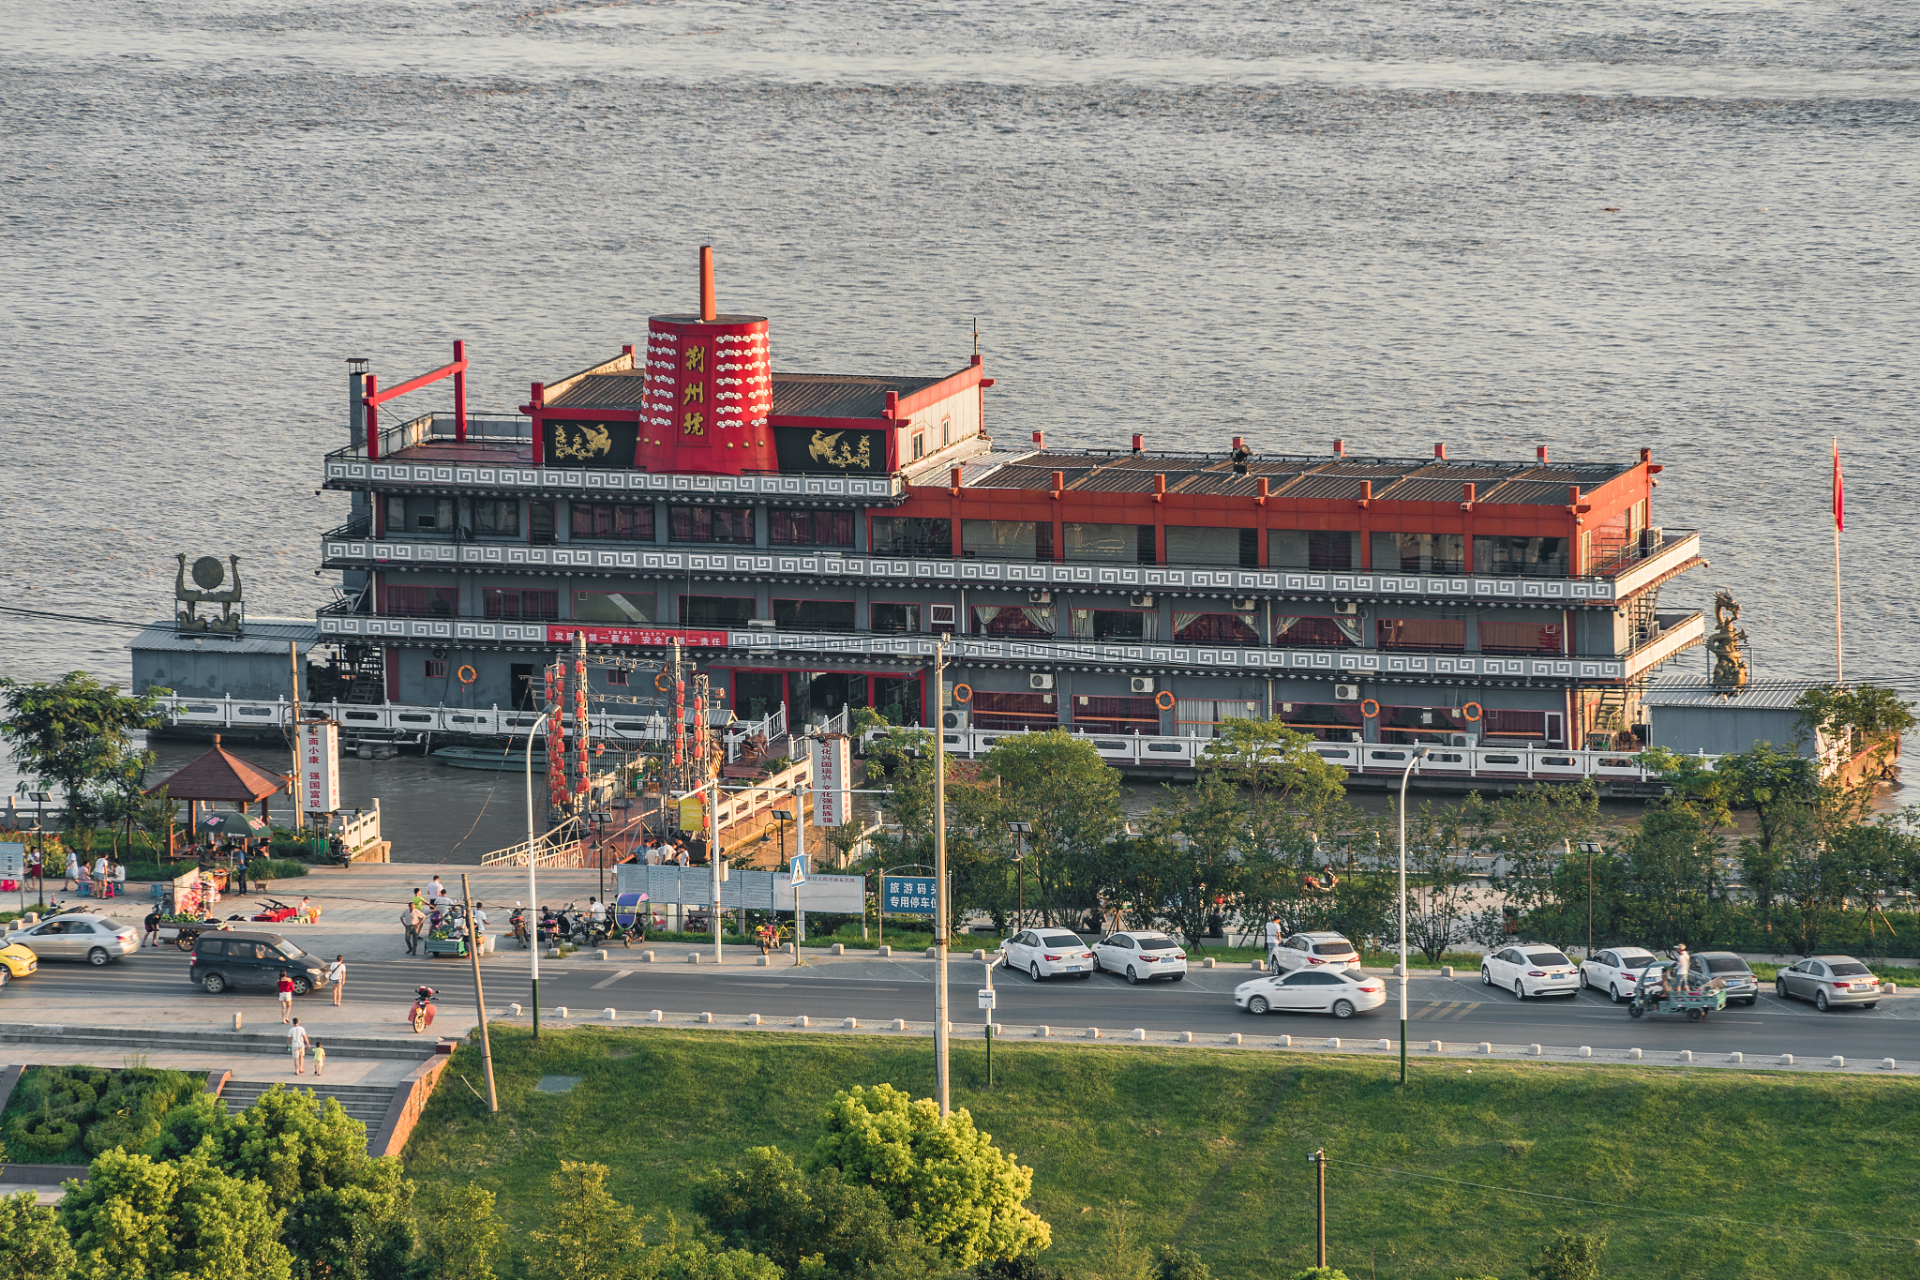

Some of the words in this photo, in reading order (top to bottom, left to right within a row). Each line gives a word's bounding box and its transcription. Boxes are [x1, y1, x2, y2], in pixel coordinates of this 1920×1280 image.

[555, 632, 631, 644] 发展第一要务
[821, 742, 832, 780] 文化兴国运兴
[309, 772, 320, 808] 强国富民
[822, 785, 833, 823] 文化强民族强
